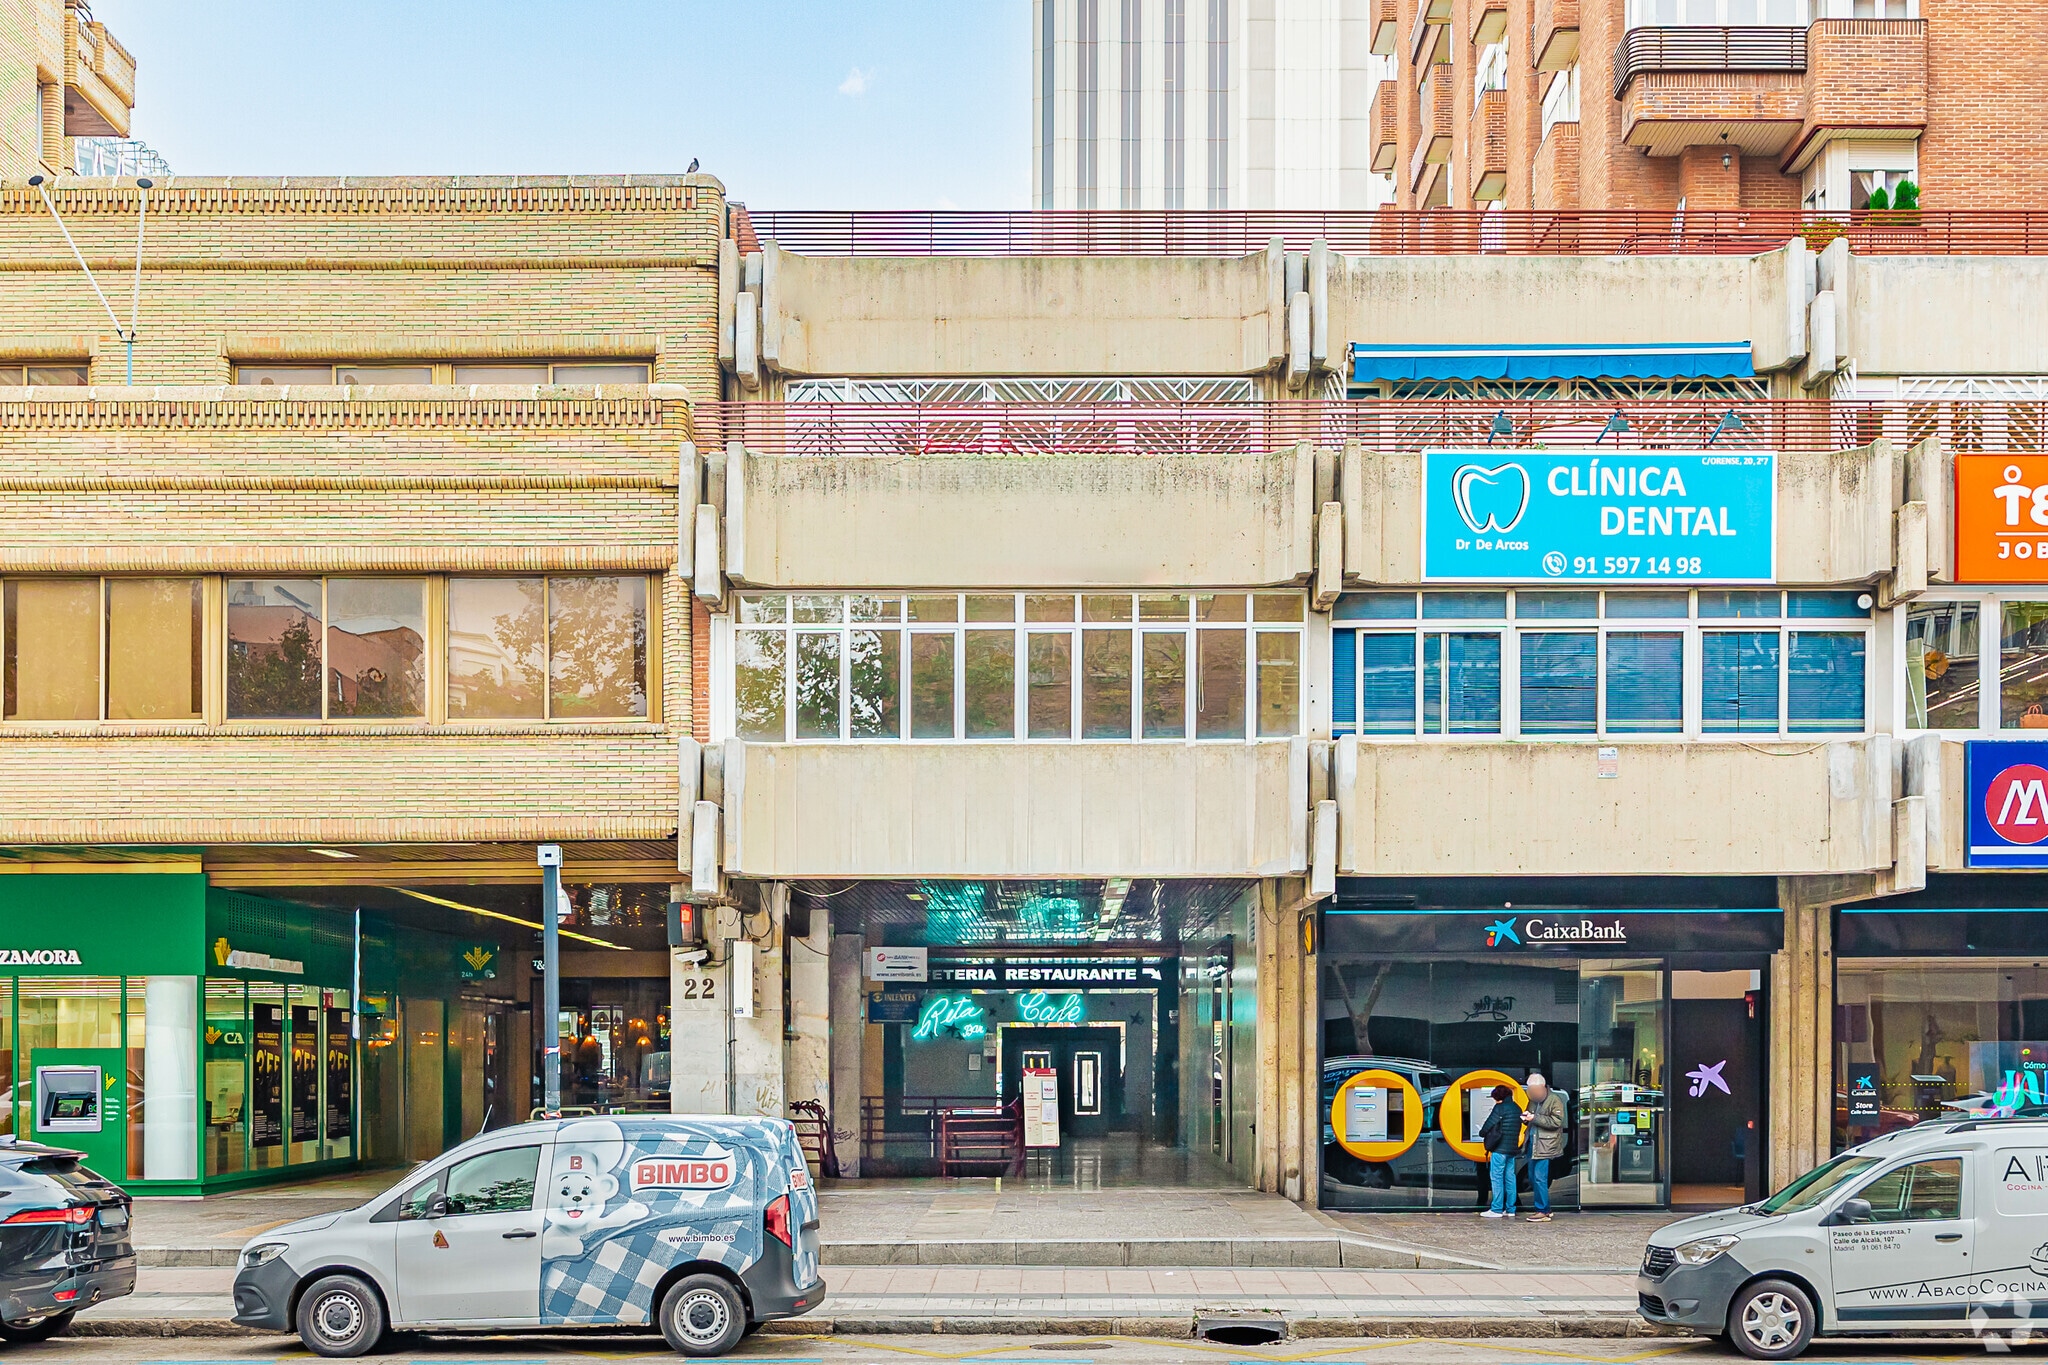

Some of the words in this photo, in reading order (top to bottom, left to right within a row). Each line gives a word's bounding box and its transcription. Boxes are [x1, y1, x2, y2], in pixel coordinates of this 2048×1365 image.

[1547, 458, 1687, 497] CLÍNICA
[1600, 506, 1737, 536] DENTAL
[1456, 539, 1470, 550] Dr
[1476, 539, 1492, 550] De
[1495, 539, 1529, 550] Arcos
[1573, 556, 1598, 574] 91
[1604, 556, 1641, 574] 597
[1646, 556, 1671, 574] 14
[1676, 556, 1702, 574] 98
[1525, 919, 1627, 939] CaixaBank
[0, 949, 83, 965] ZAMORA
[1005, 968, 1137, 981] RESTAURANTE
[684, 978, 715, 999] 22
[1019, 992, 1082, 1022] Café
[569, 1155, 583, 1170] B
[637, 1163, 729, 1185] BIMBO
[668, 1234, 735, 1243] www.bimbo.es
